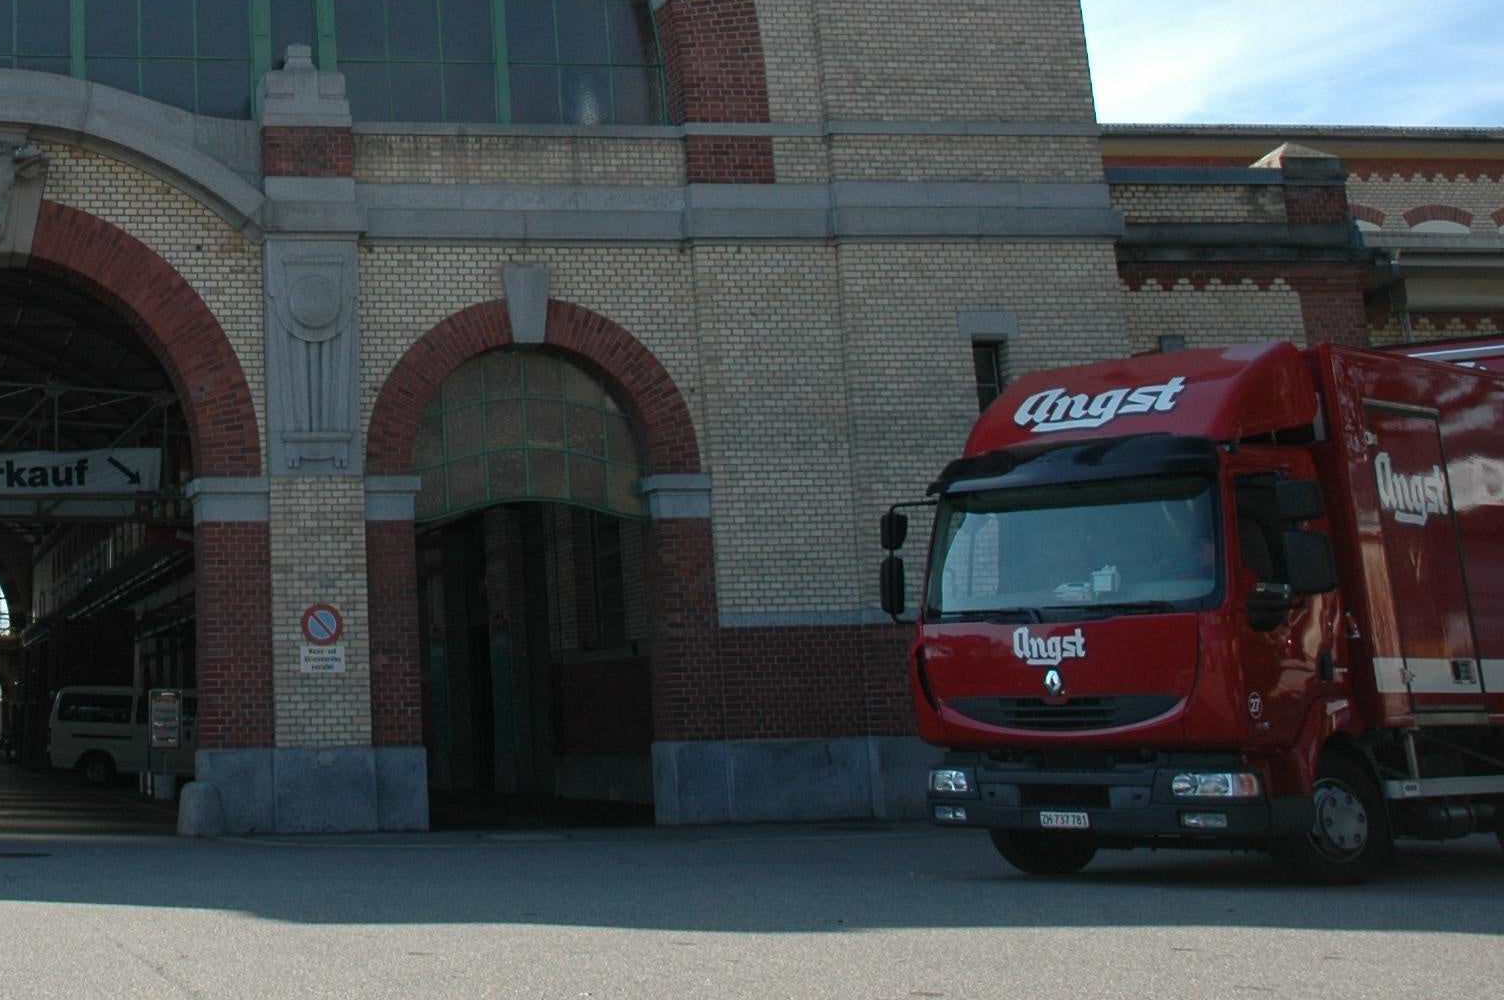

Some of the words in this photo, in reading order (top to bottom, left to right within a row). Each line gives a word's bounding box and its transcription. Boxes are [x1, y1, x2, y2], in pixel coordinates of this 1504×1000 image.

[1013, 376, 1187, 433] Angst
[1374, 452, 1448, 526] Angst
[1012, 626, 1086, 666] Angst
